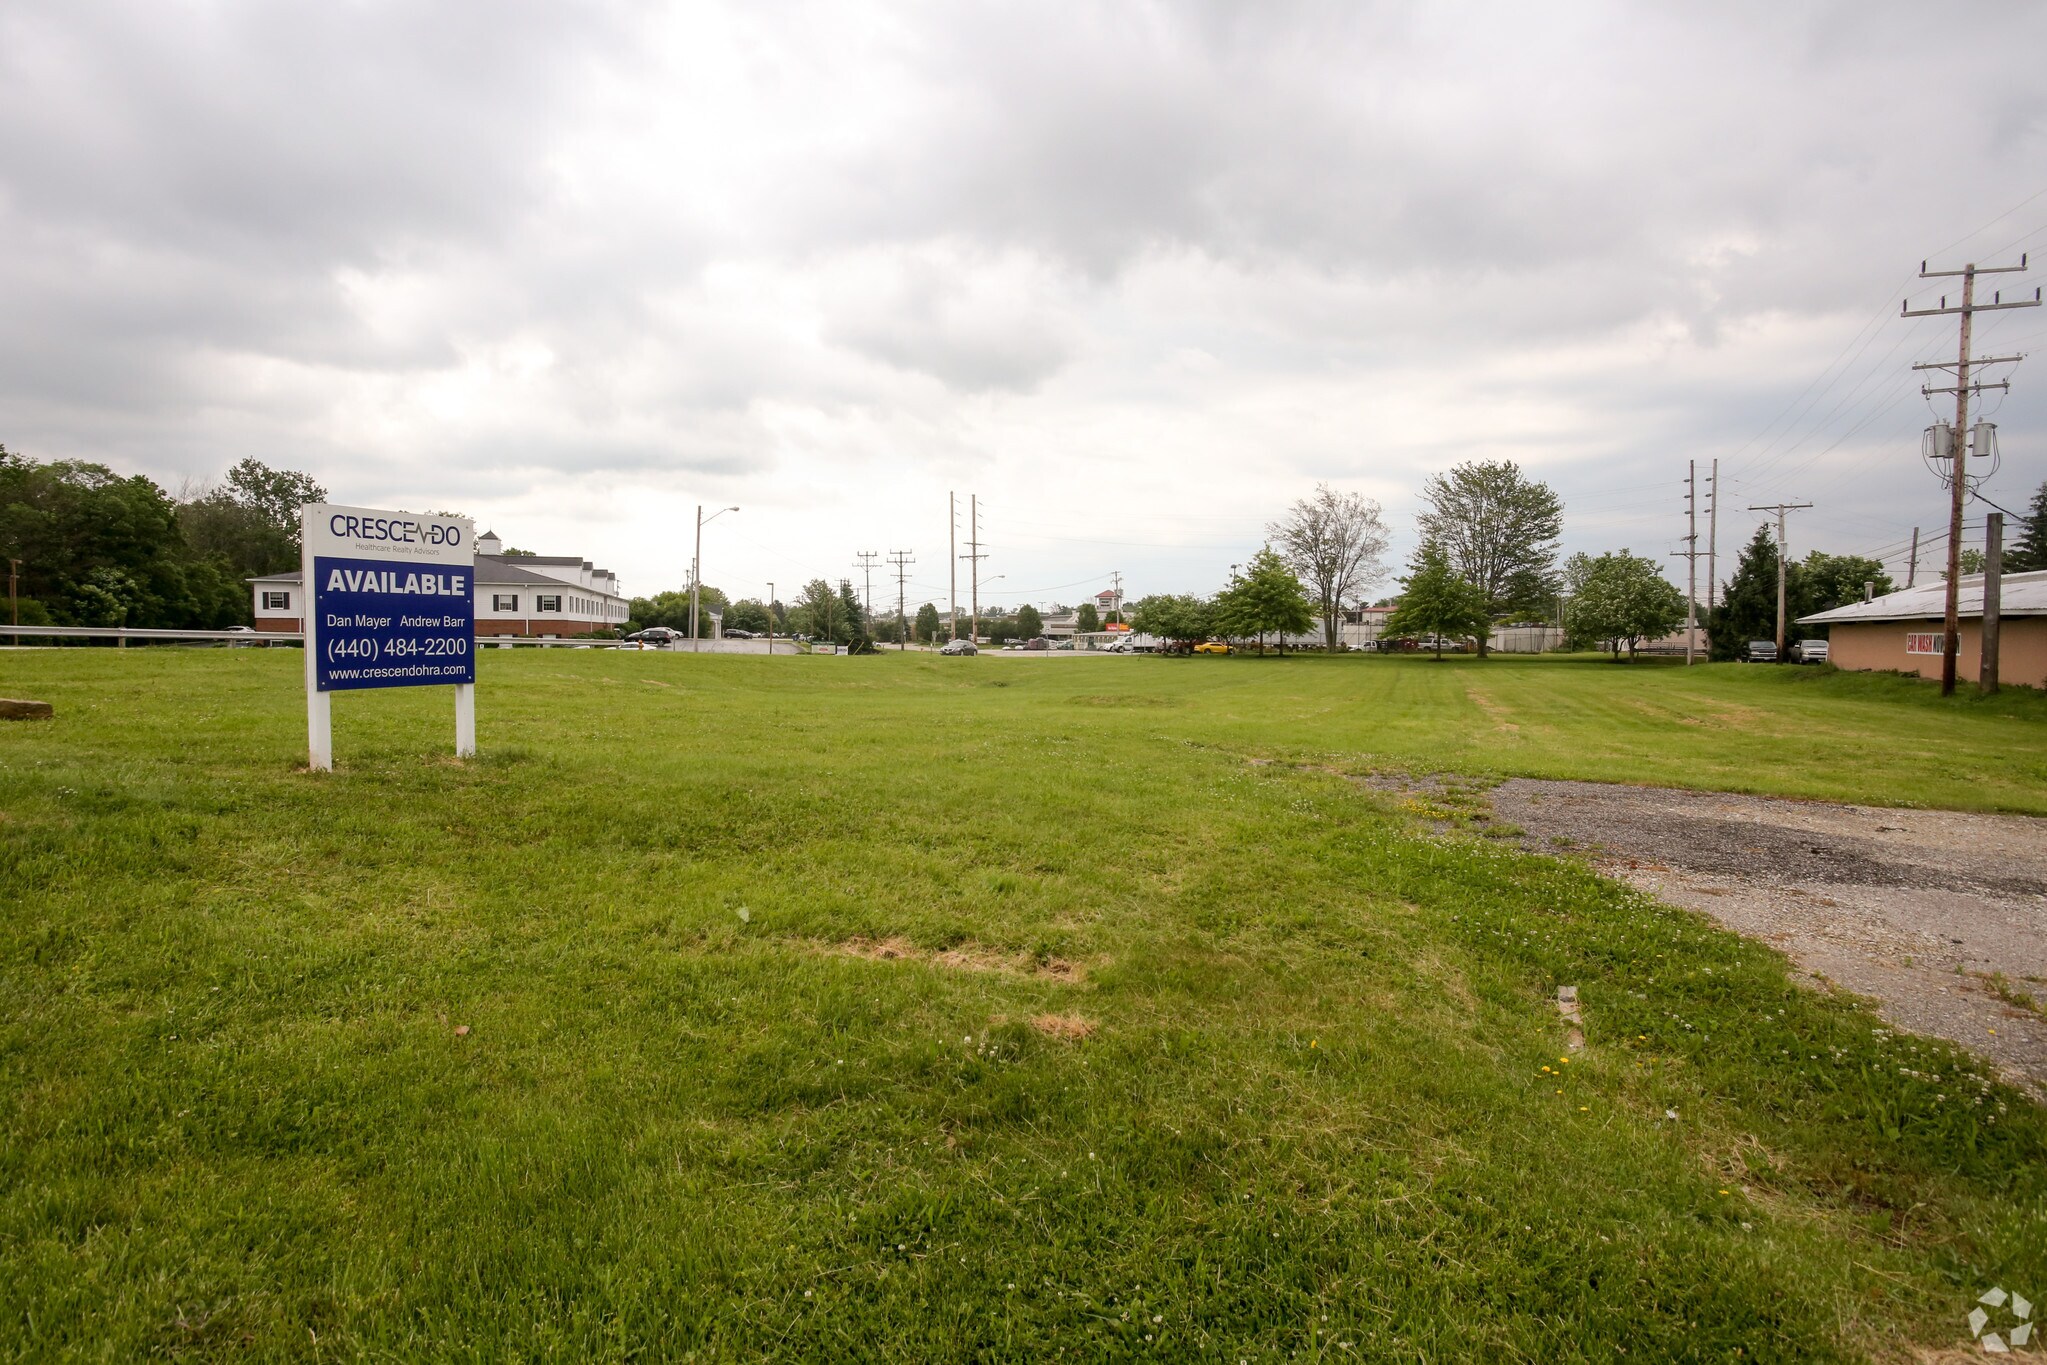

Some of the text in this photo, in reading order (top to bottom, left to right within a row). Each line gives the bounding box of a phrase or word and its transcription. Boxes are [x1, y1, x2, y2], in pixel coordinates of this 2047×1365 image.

[356, 542, 440, 556] Healthcare Realty Advisors
[327, 569, 465, 596] AVAILABLE
[327, 614, 465, 630] Dan Mayer Andrew Barr
[328, 638, 466, 662] (440) 484-2200
[1908, 634, 1916, 652] CAR
[1918, 634, 1932, 652] WASH
[329, 664, 466, 680] www.crescendohra.com
